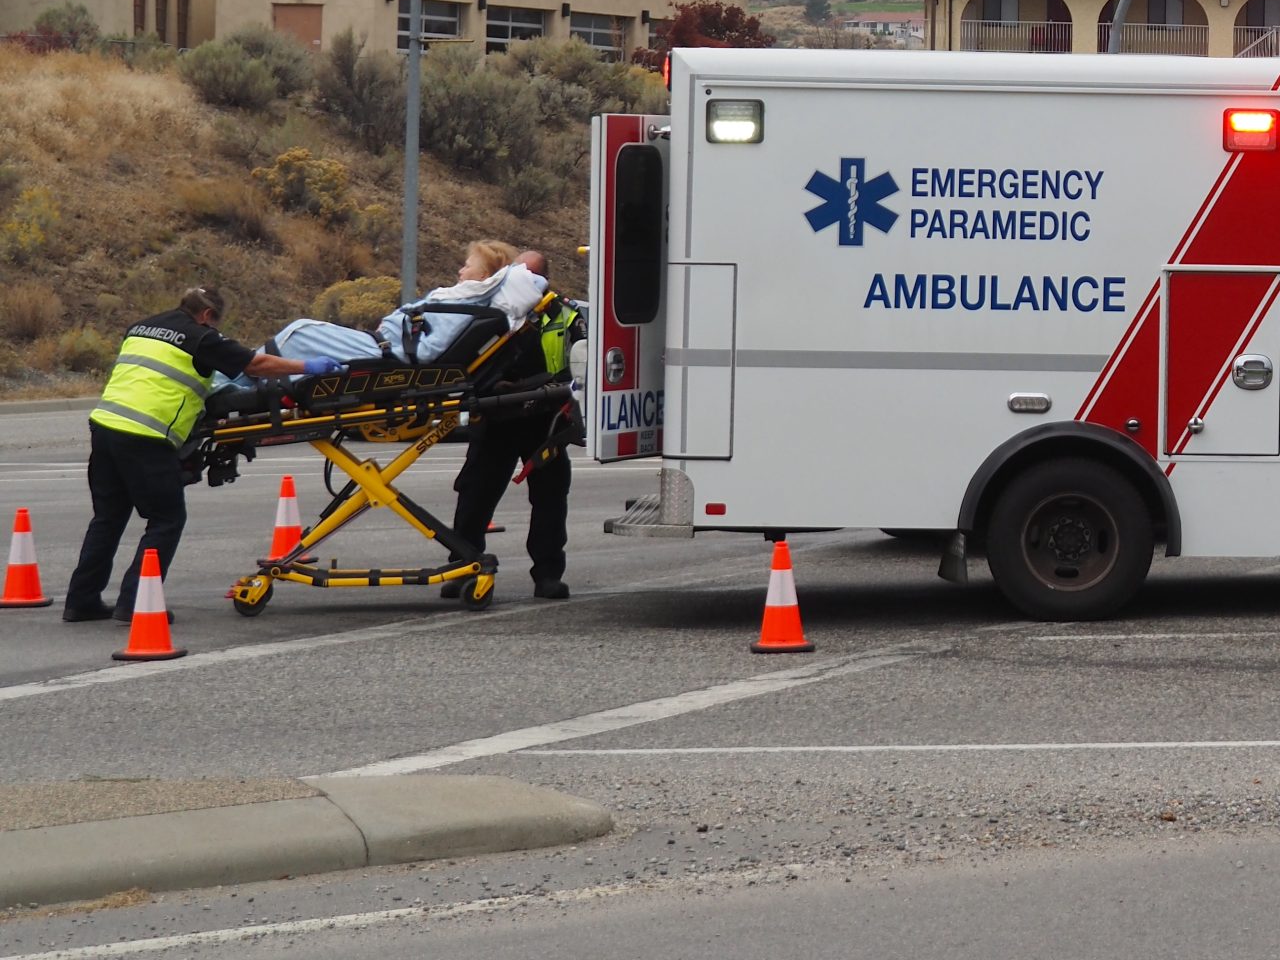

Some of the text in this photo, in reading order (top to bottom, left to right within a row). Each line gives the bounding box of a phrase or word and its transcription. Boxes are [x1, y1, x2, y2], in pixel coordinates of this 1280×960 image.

[911, 167, 1104, 200] EMERGENCY
[910, 209, 1091, 242] PARAMEDIC
[863, 273, 1126, 312] AMBULANCE
